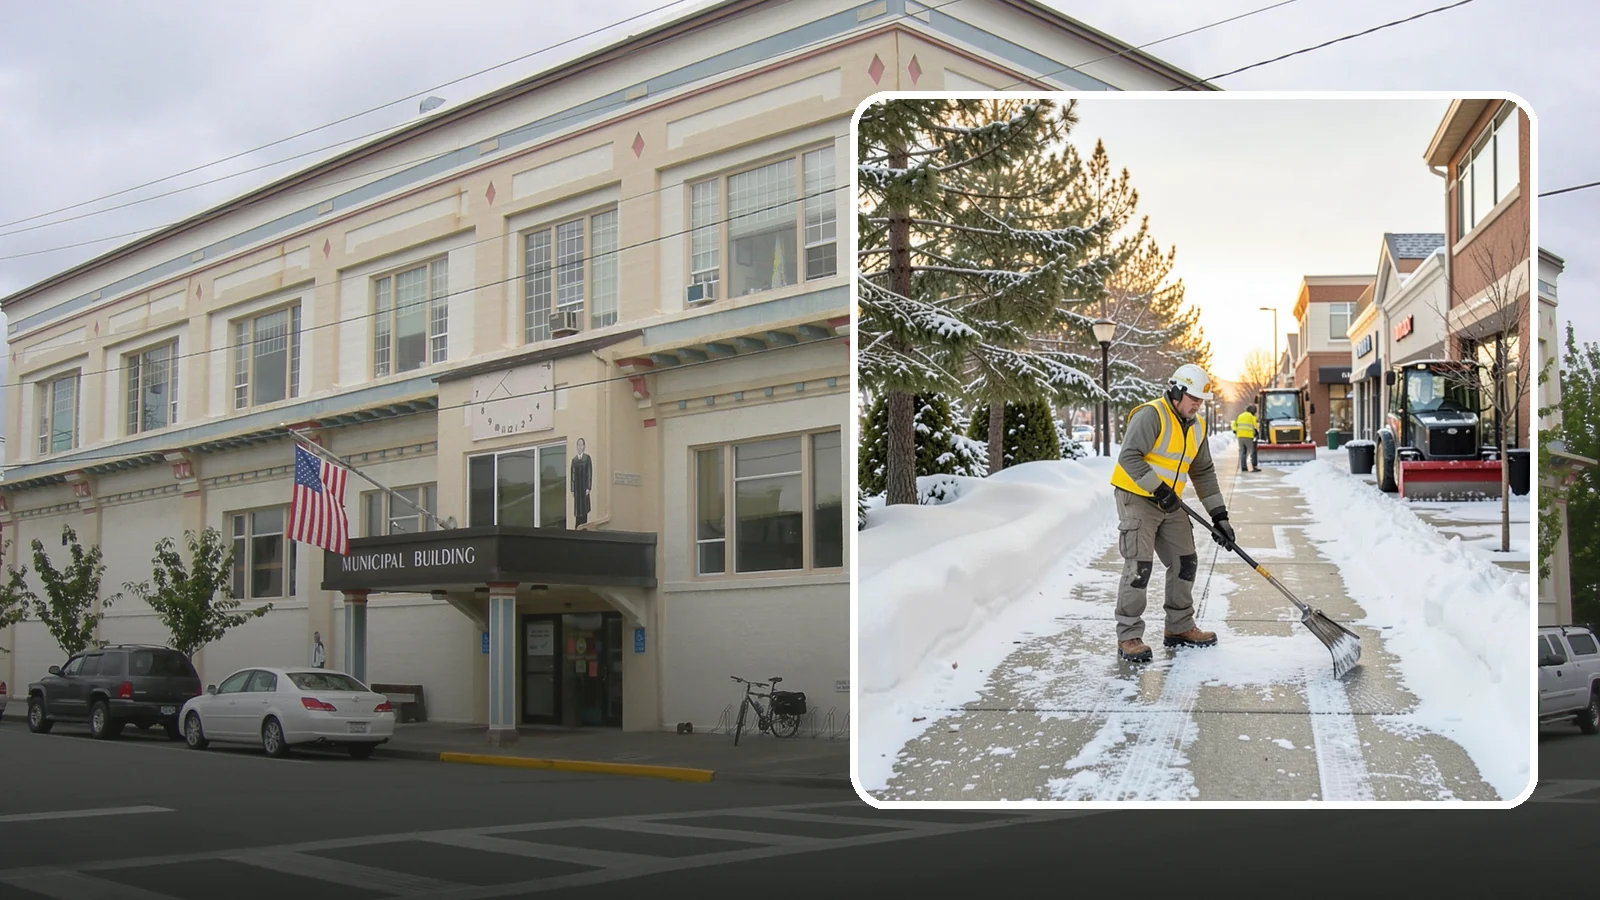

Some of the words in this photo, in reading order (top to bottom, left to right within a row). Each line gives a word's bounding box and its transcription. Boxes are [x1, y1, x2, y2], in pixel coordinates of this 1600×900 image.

[487, 417, 492, 426] 9
[494, 423, 500, 432] 10
[507, 425, 513, 433] 12
[342, 552, 405, 572] MUNICIPAL
[414, 546, 475, 567] BUILDING
